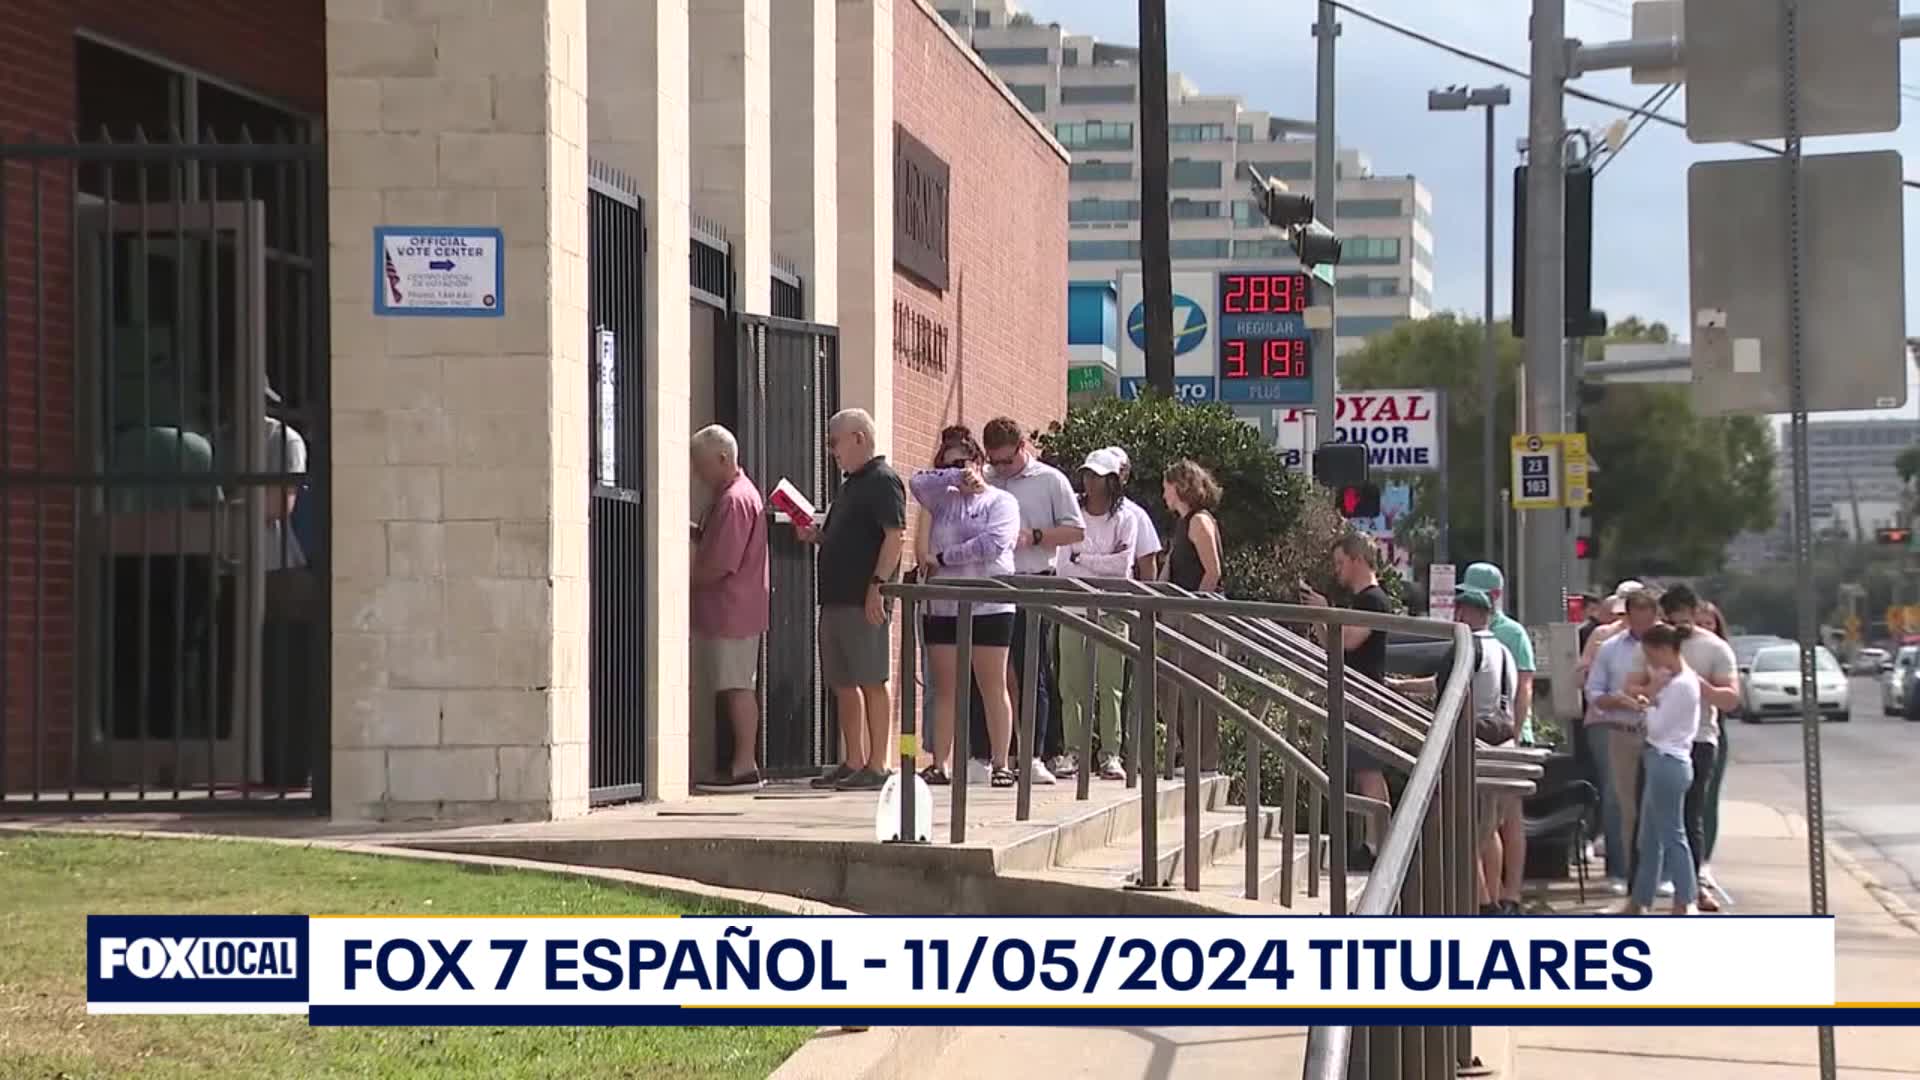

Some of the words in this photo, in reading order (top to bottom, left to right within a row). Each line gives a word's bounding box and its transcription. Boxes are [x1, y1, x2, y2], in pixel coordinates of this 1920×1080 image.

[410, 238, 467, 247] OFFICIAL
[397, 247, 430, 256] VOTE
[434, 247, 484, 256] CENTER
[1225, 276, 1291, 312] 2.89
[1237, 320, 1293, 334] REGULAR
[1226, 341, 1290, 377] 3.19
[1249, 384, 1281, 399] PLUS
[1284, 396, 1431, 422] YAL
[1335, 426, 1409, 444] QUOR
[1368, 448, 1429, 465] WINE
[1528, 460, 1543, 473] 23
[1526, 480, 1547, 493] 103
